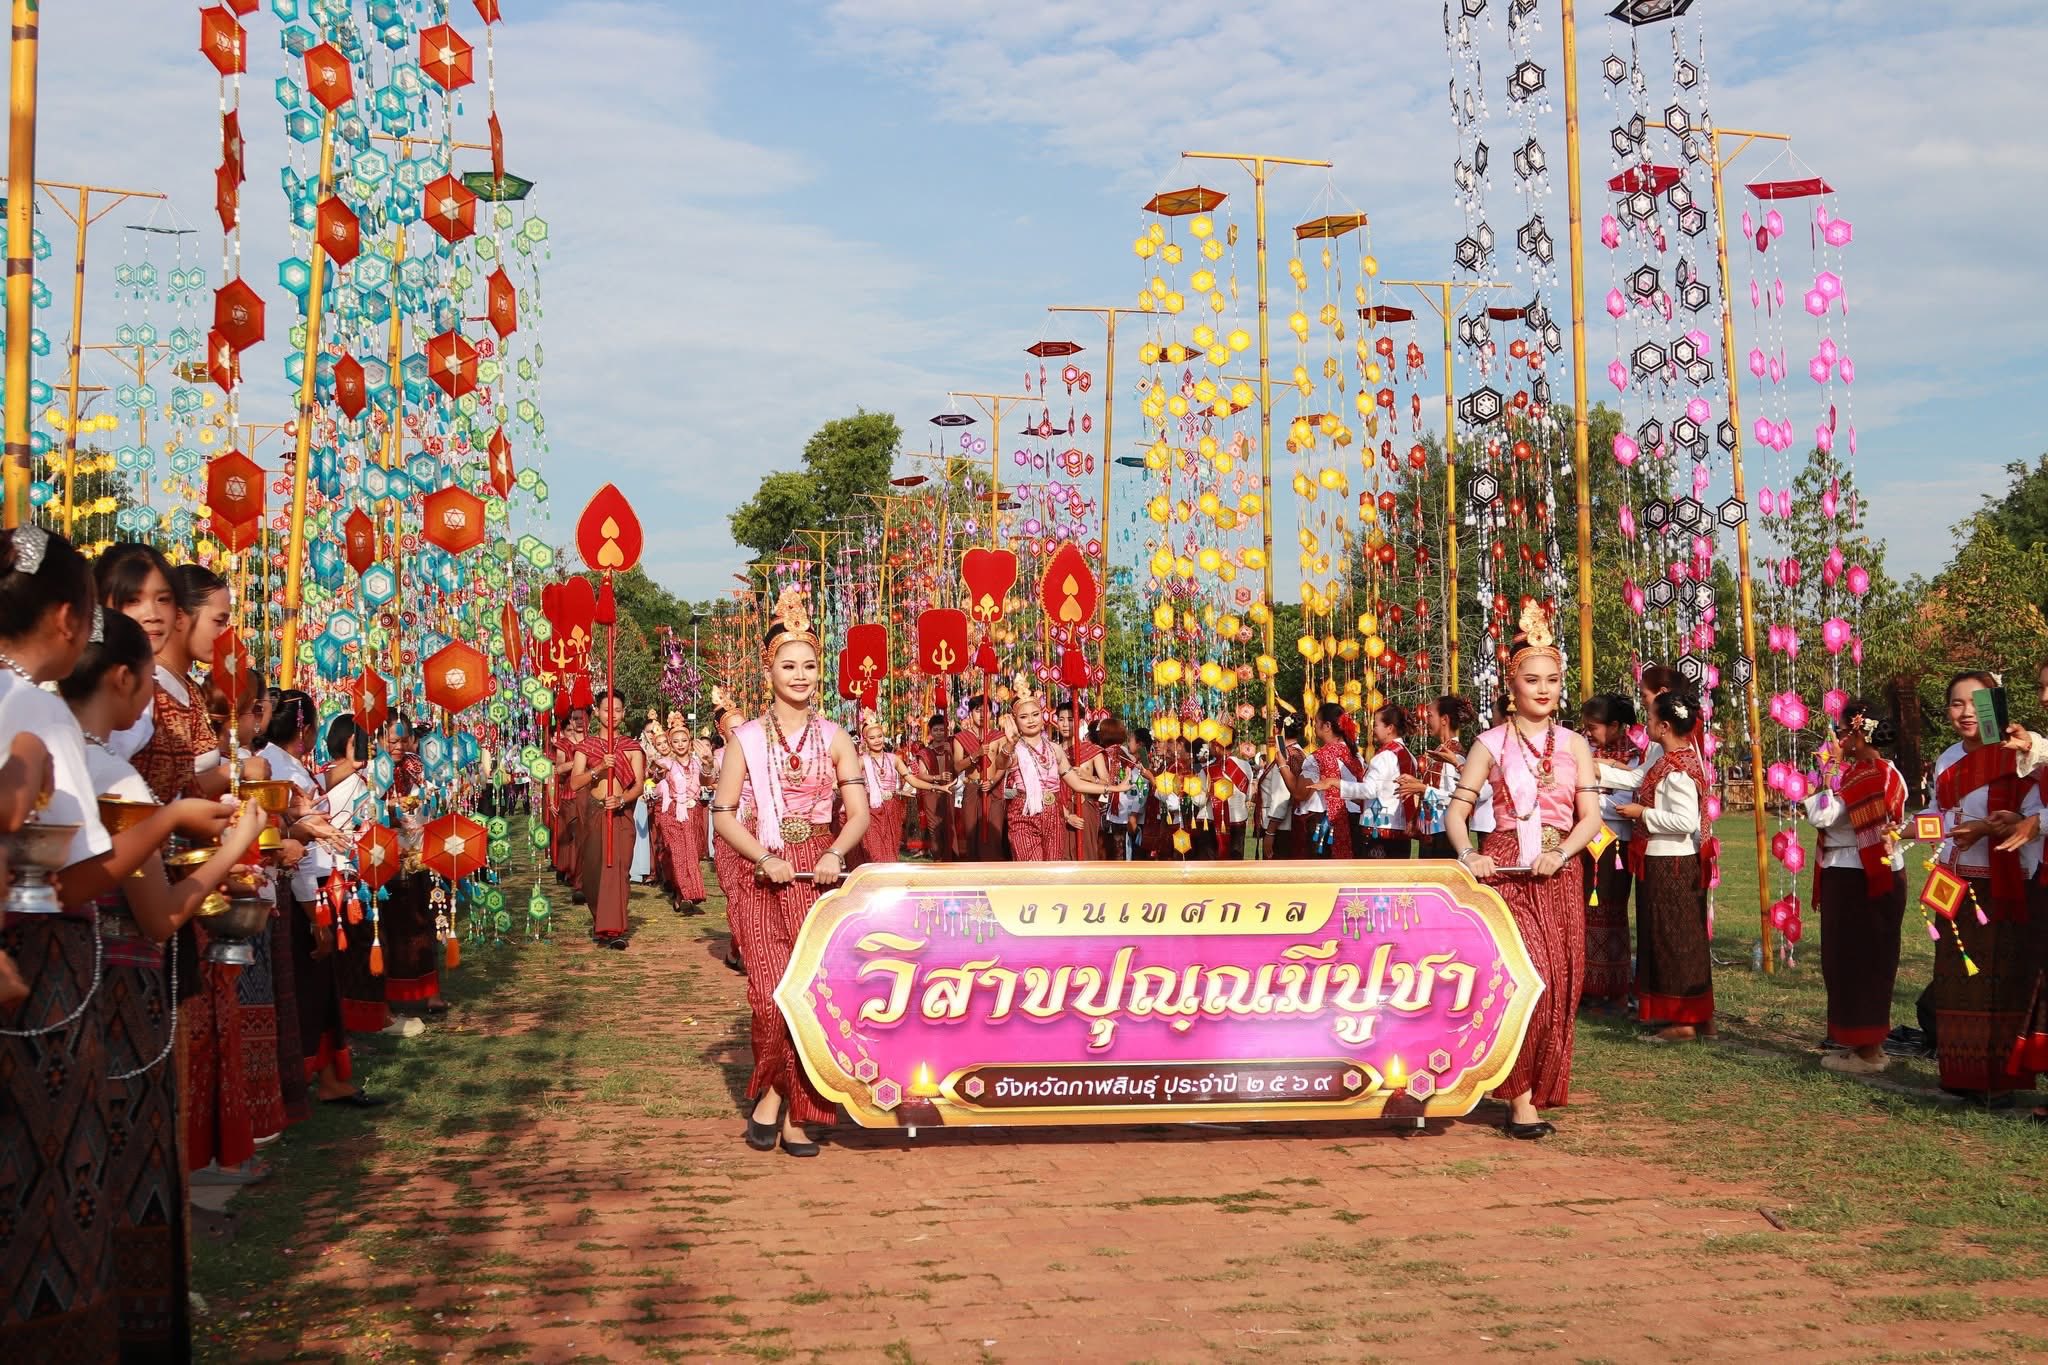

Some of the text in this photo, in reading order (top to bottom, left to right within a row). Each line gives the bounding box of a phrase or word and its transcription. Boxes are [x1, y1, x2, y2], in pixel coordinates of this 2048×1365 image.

[1018, 898, 1308, 924] งานเทศกาล
[995, 1075, 1161, 1100] จังหวัดกาฬสินธุ์
